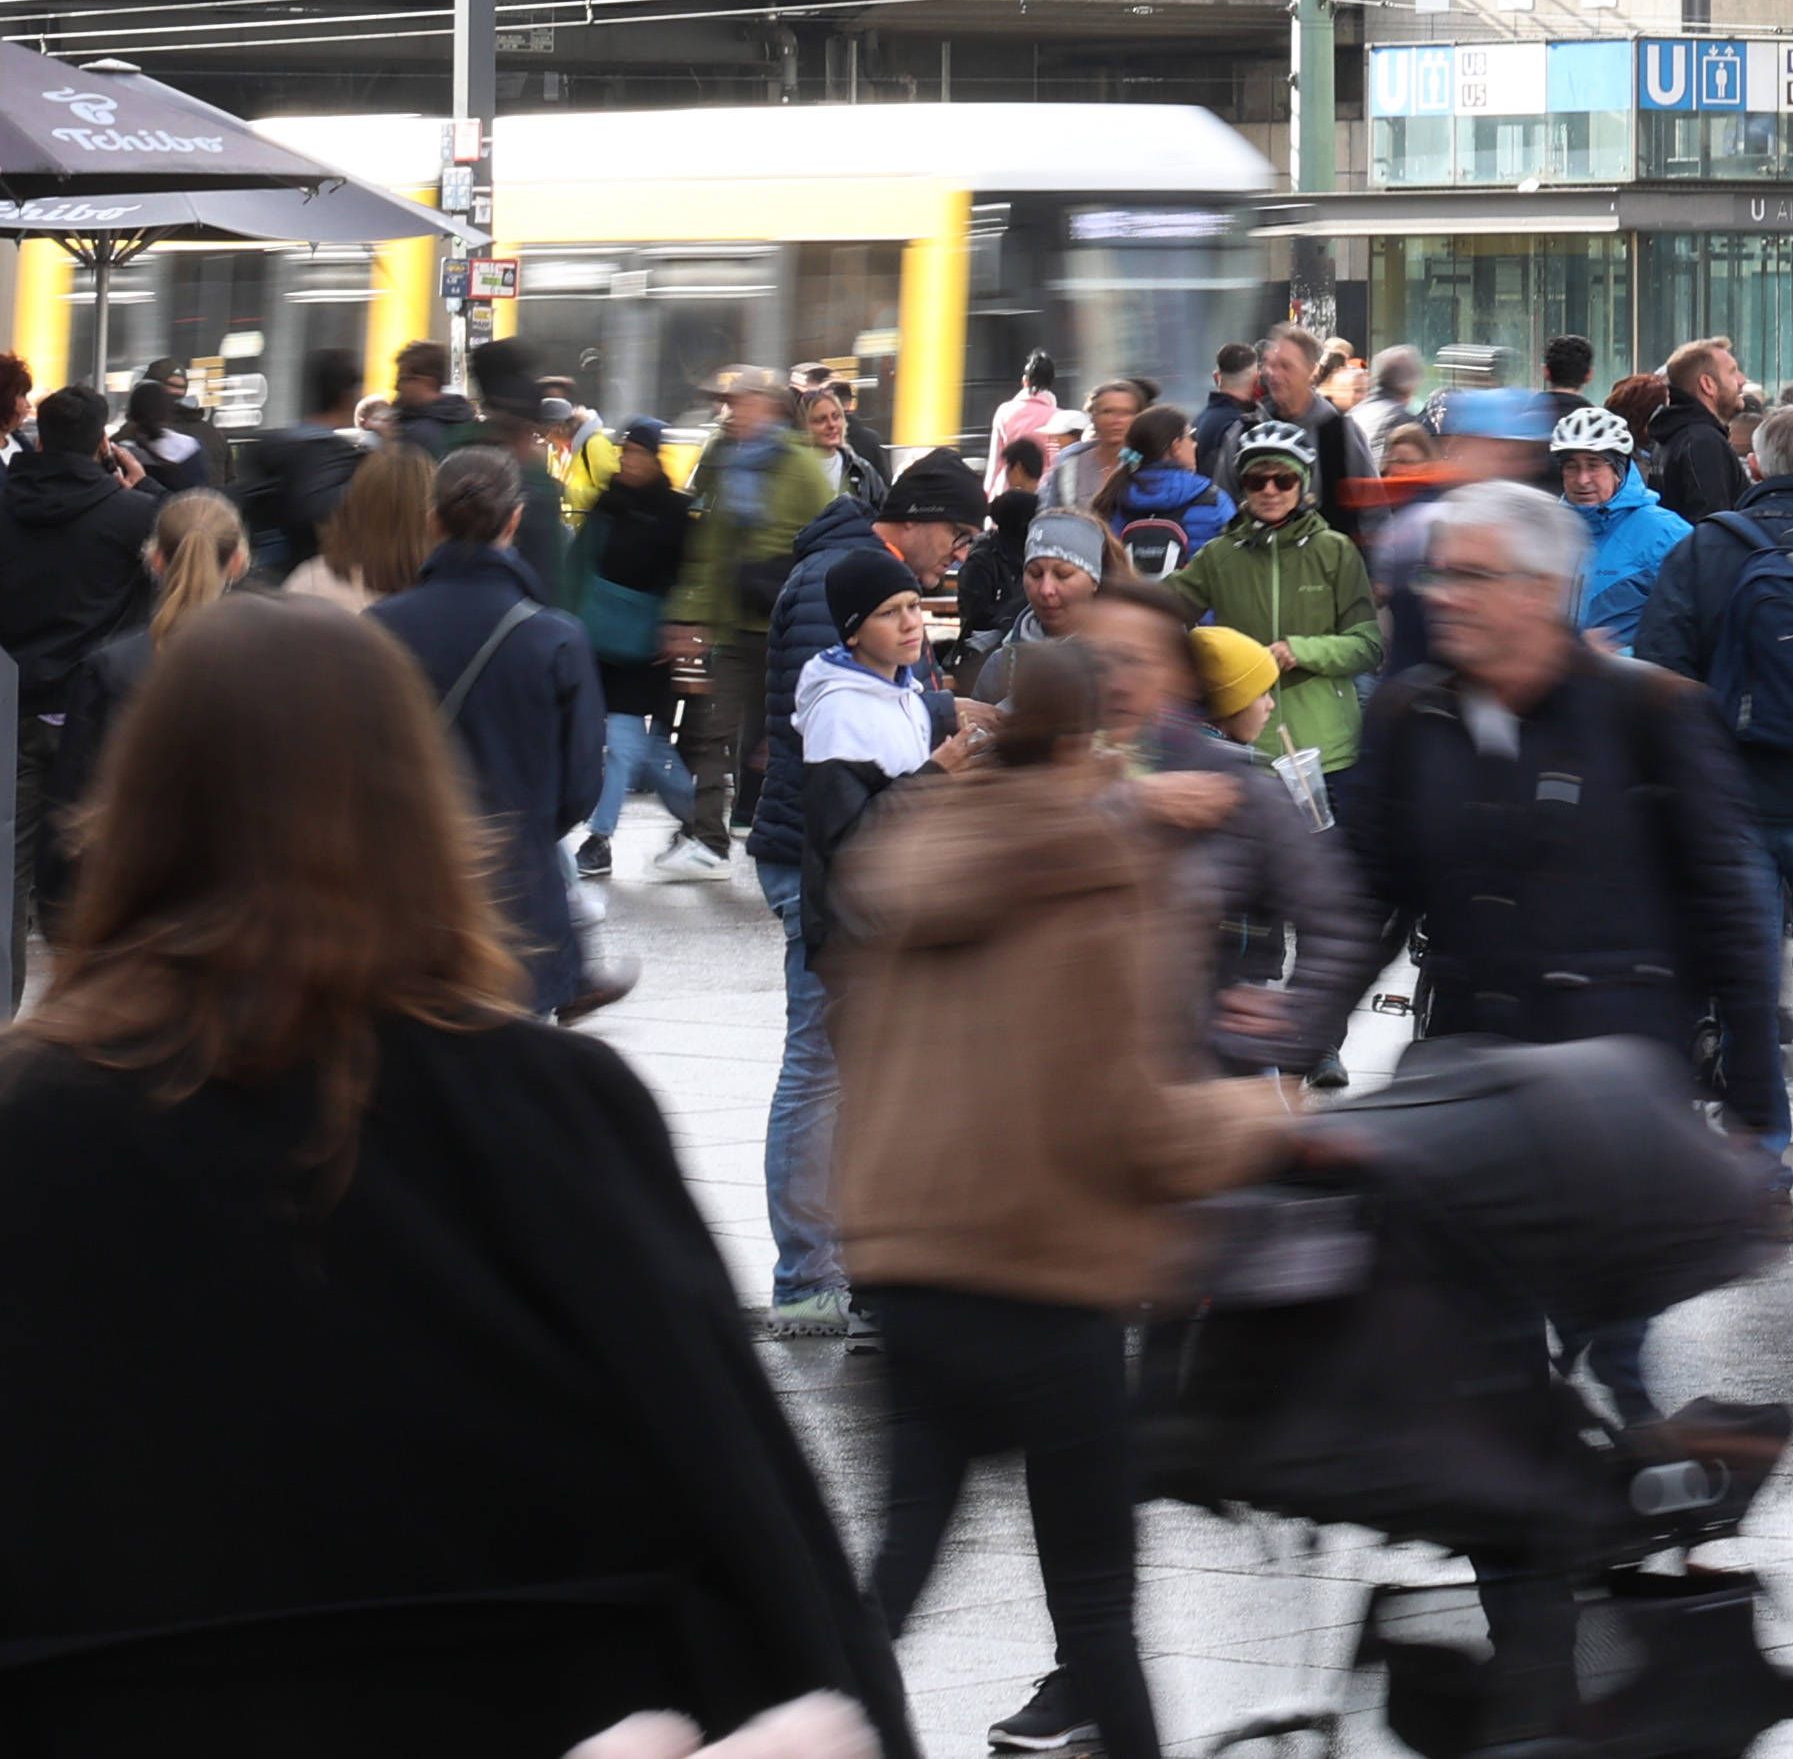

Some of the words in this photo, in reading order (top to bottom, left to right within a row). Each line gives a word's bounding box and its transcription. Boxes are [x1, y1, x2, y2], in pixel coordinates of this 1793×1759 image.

[1376, 51, 1409, 113] U
[1646, 44, 1687, 106] U
[51, 127, 224, 154] Tchibo
[1751, 198, 1766, 222] U
